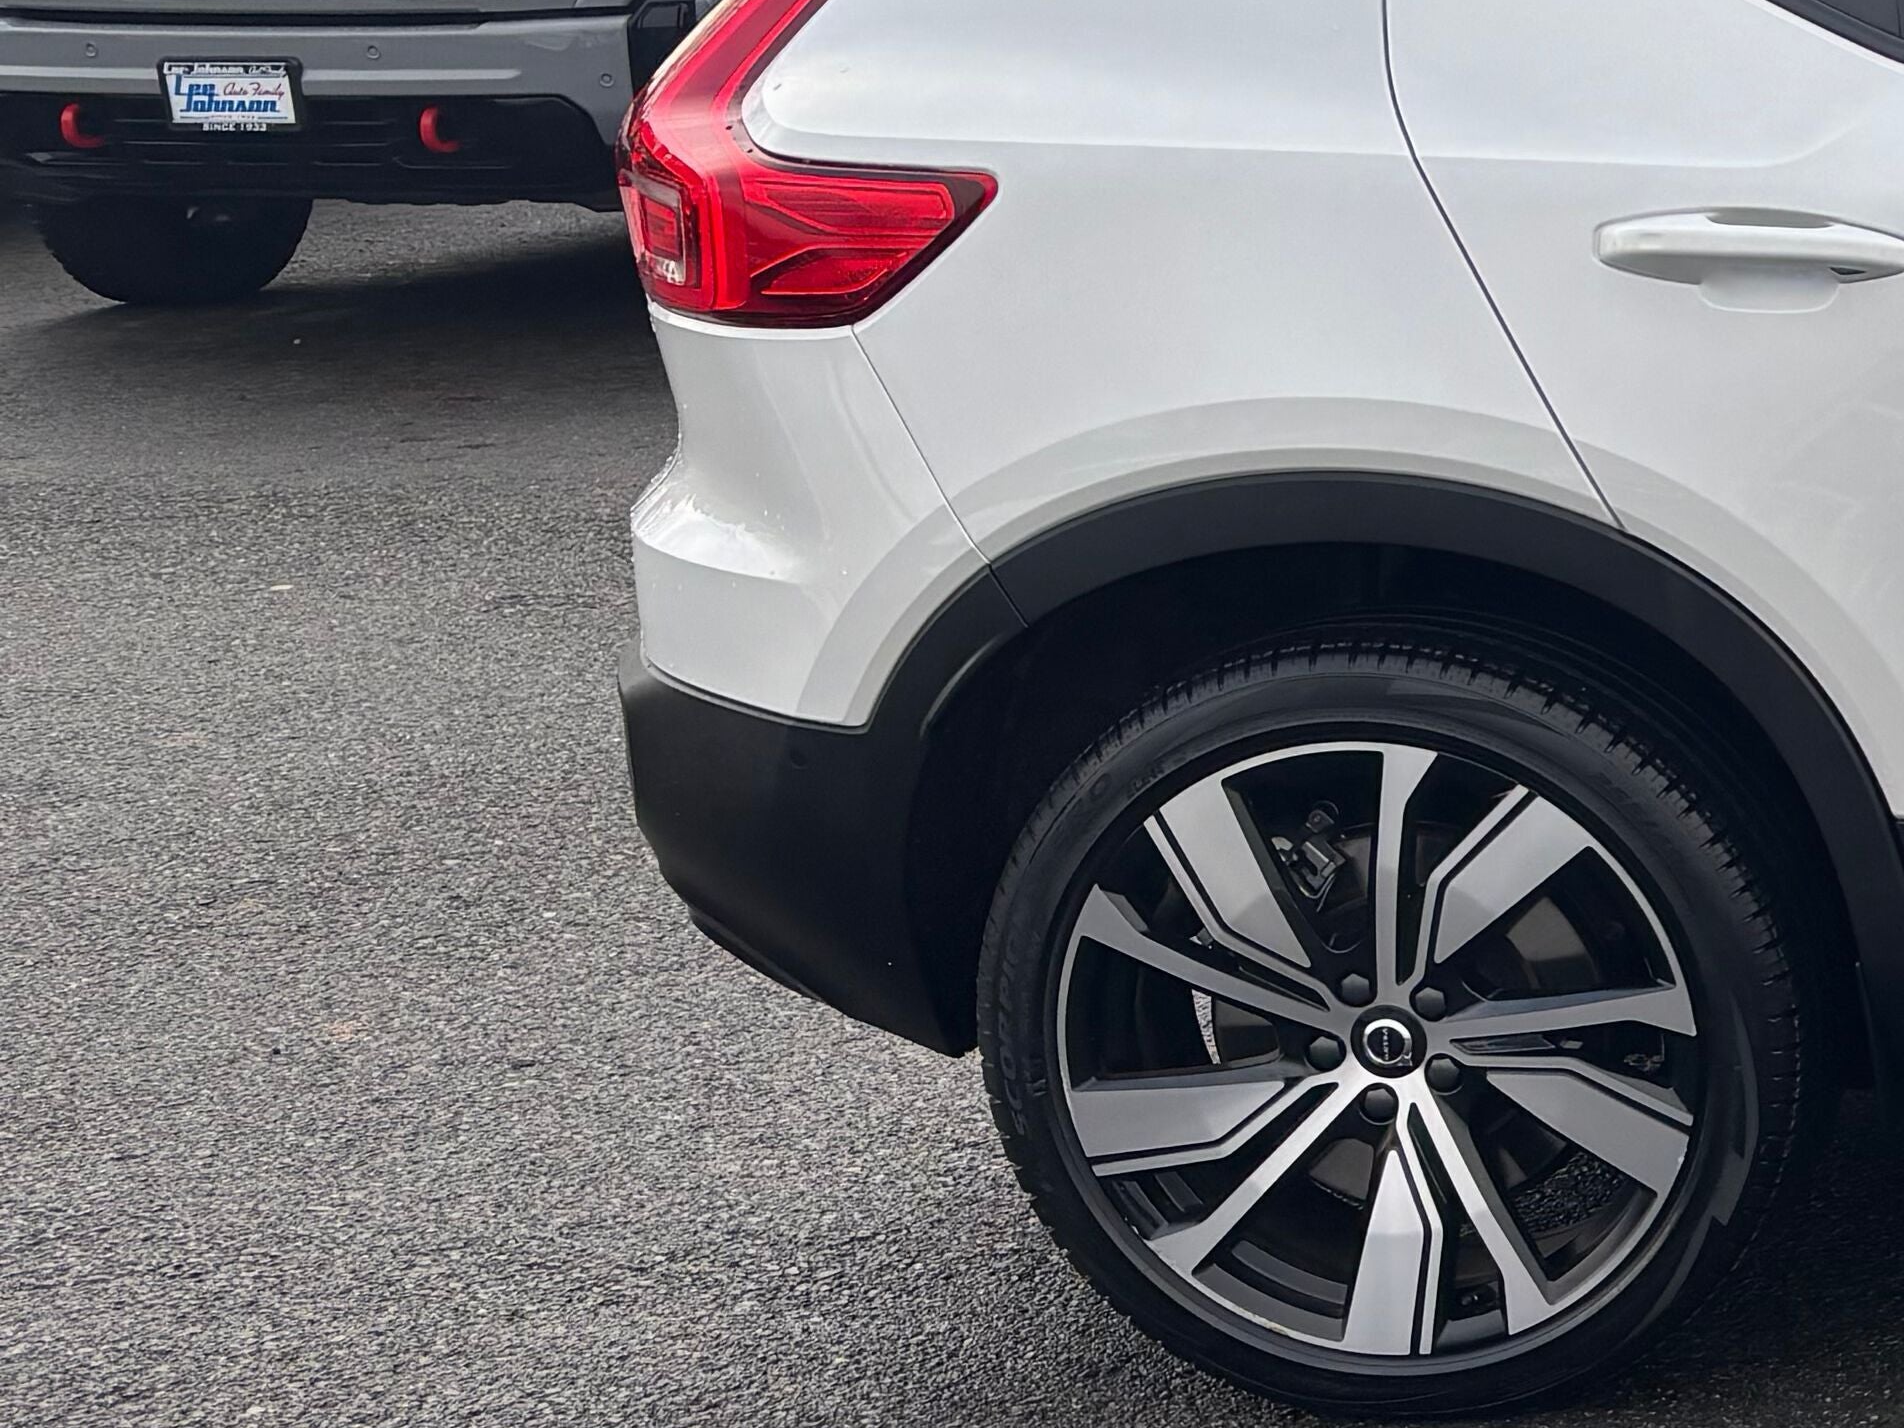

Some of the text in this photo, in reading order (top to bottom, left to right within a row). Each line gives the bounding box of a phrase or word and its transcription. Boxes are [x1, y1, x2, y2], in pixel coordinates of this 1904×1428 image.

[175, 74, 219, 96] Lee
[250, 82, 285, 100] Family
[180, 92, 280, 113] Johnson
[203, 123, 236, 131] SINCE
